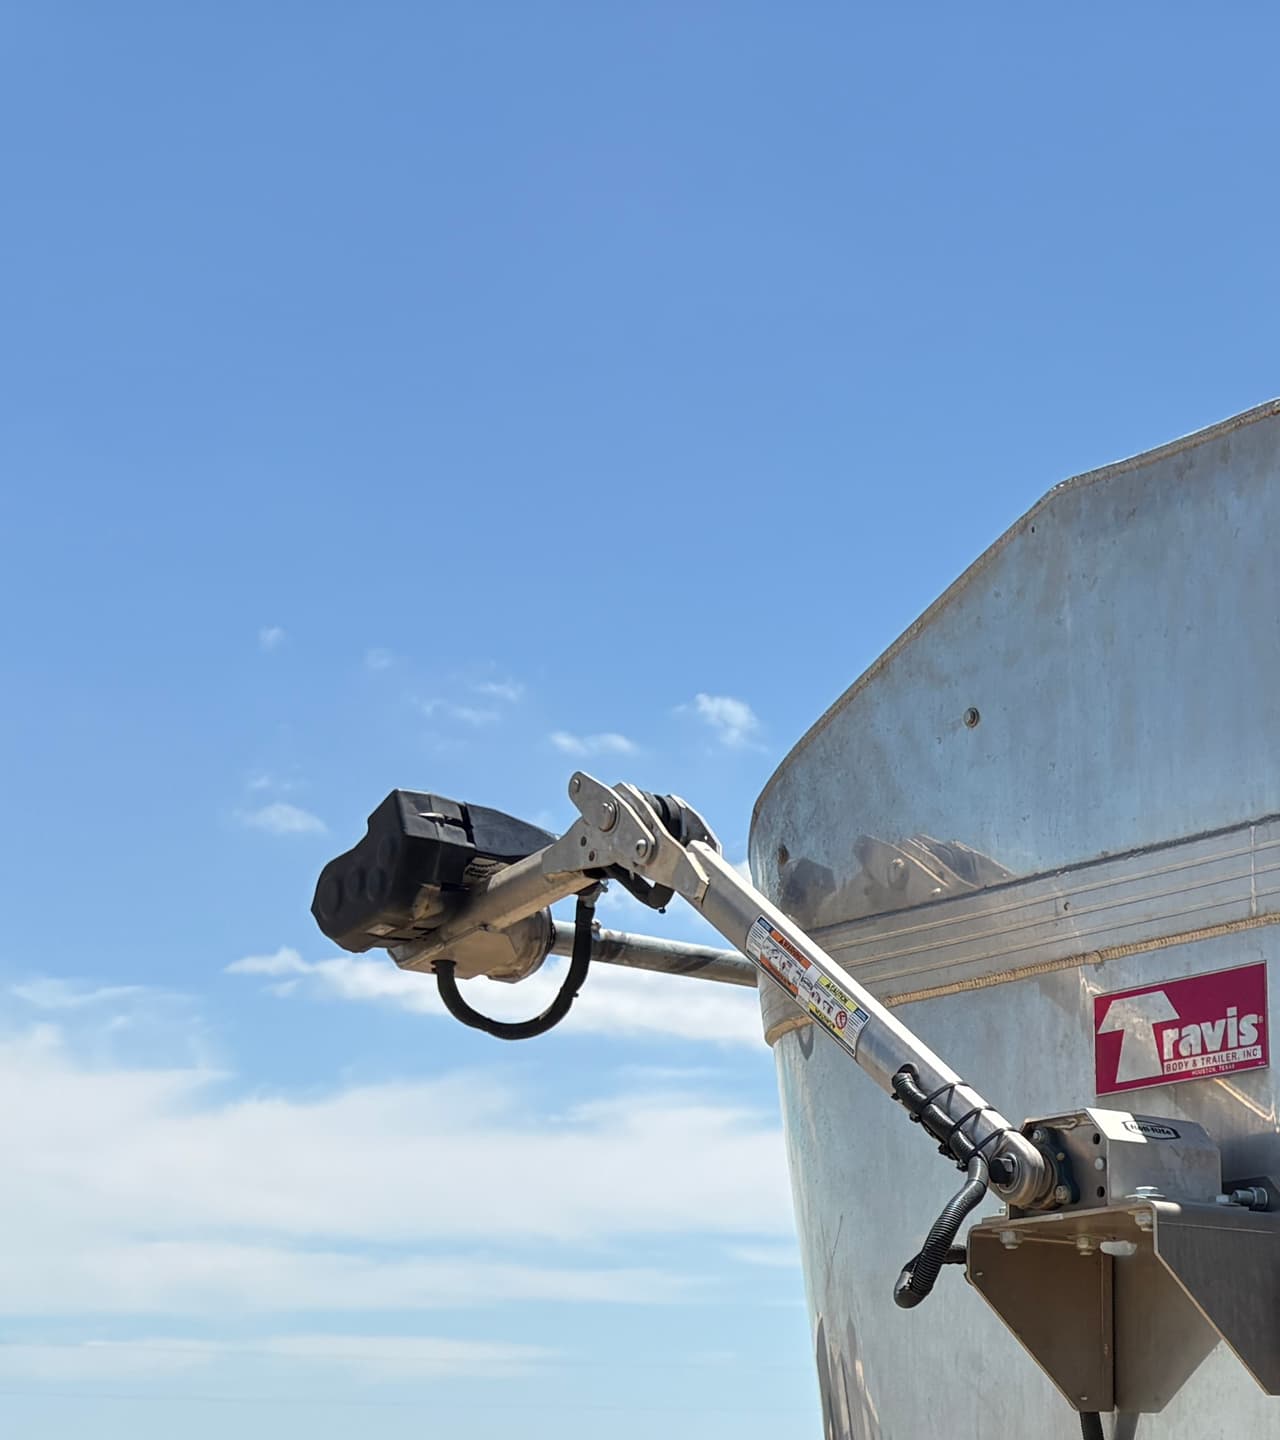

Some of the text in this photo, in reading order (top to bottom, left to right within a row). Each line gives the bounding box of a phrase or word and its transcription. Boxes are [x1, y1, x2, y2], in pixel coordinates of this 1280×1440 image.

[1097, 990, 1259, 1084] Travis
[1166, 1059, 1189, 1072] BODY
[1191, 1058, 1198, 1067] &
[1201, 1051, 1240, 1066] TRAILER,
